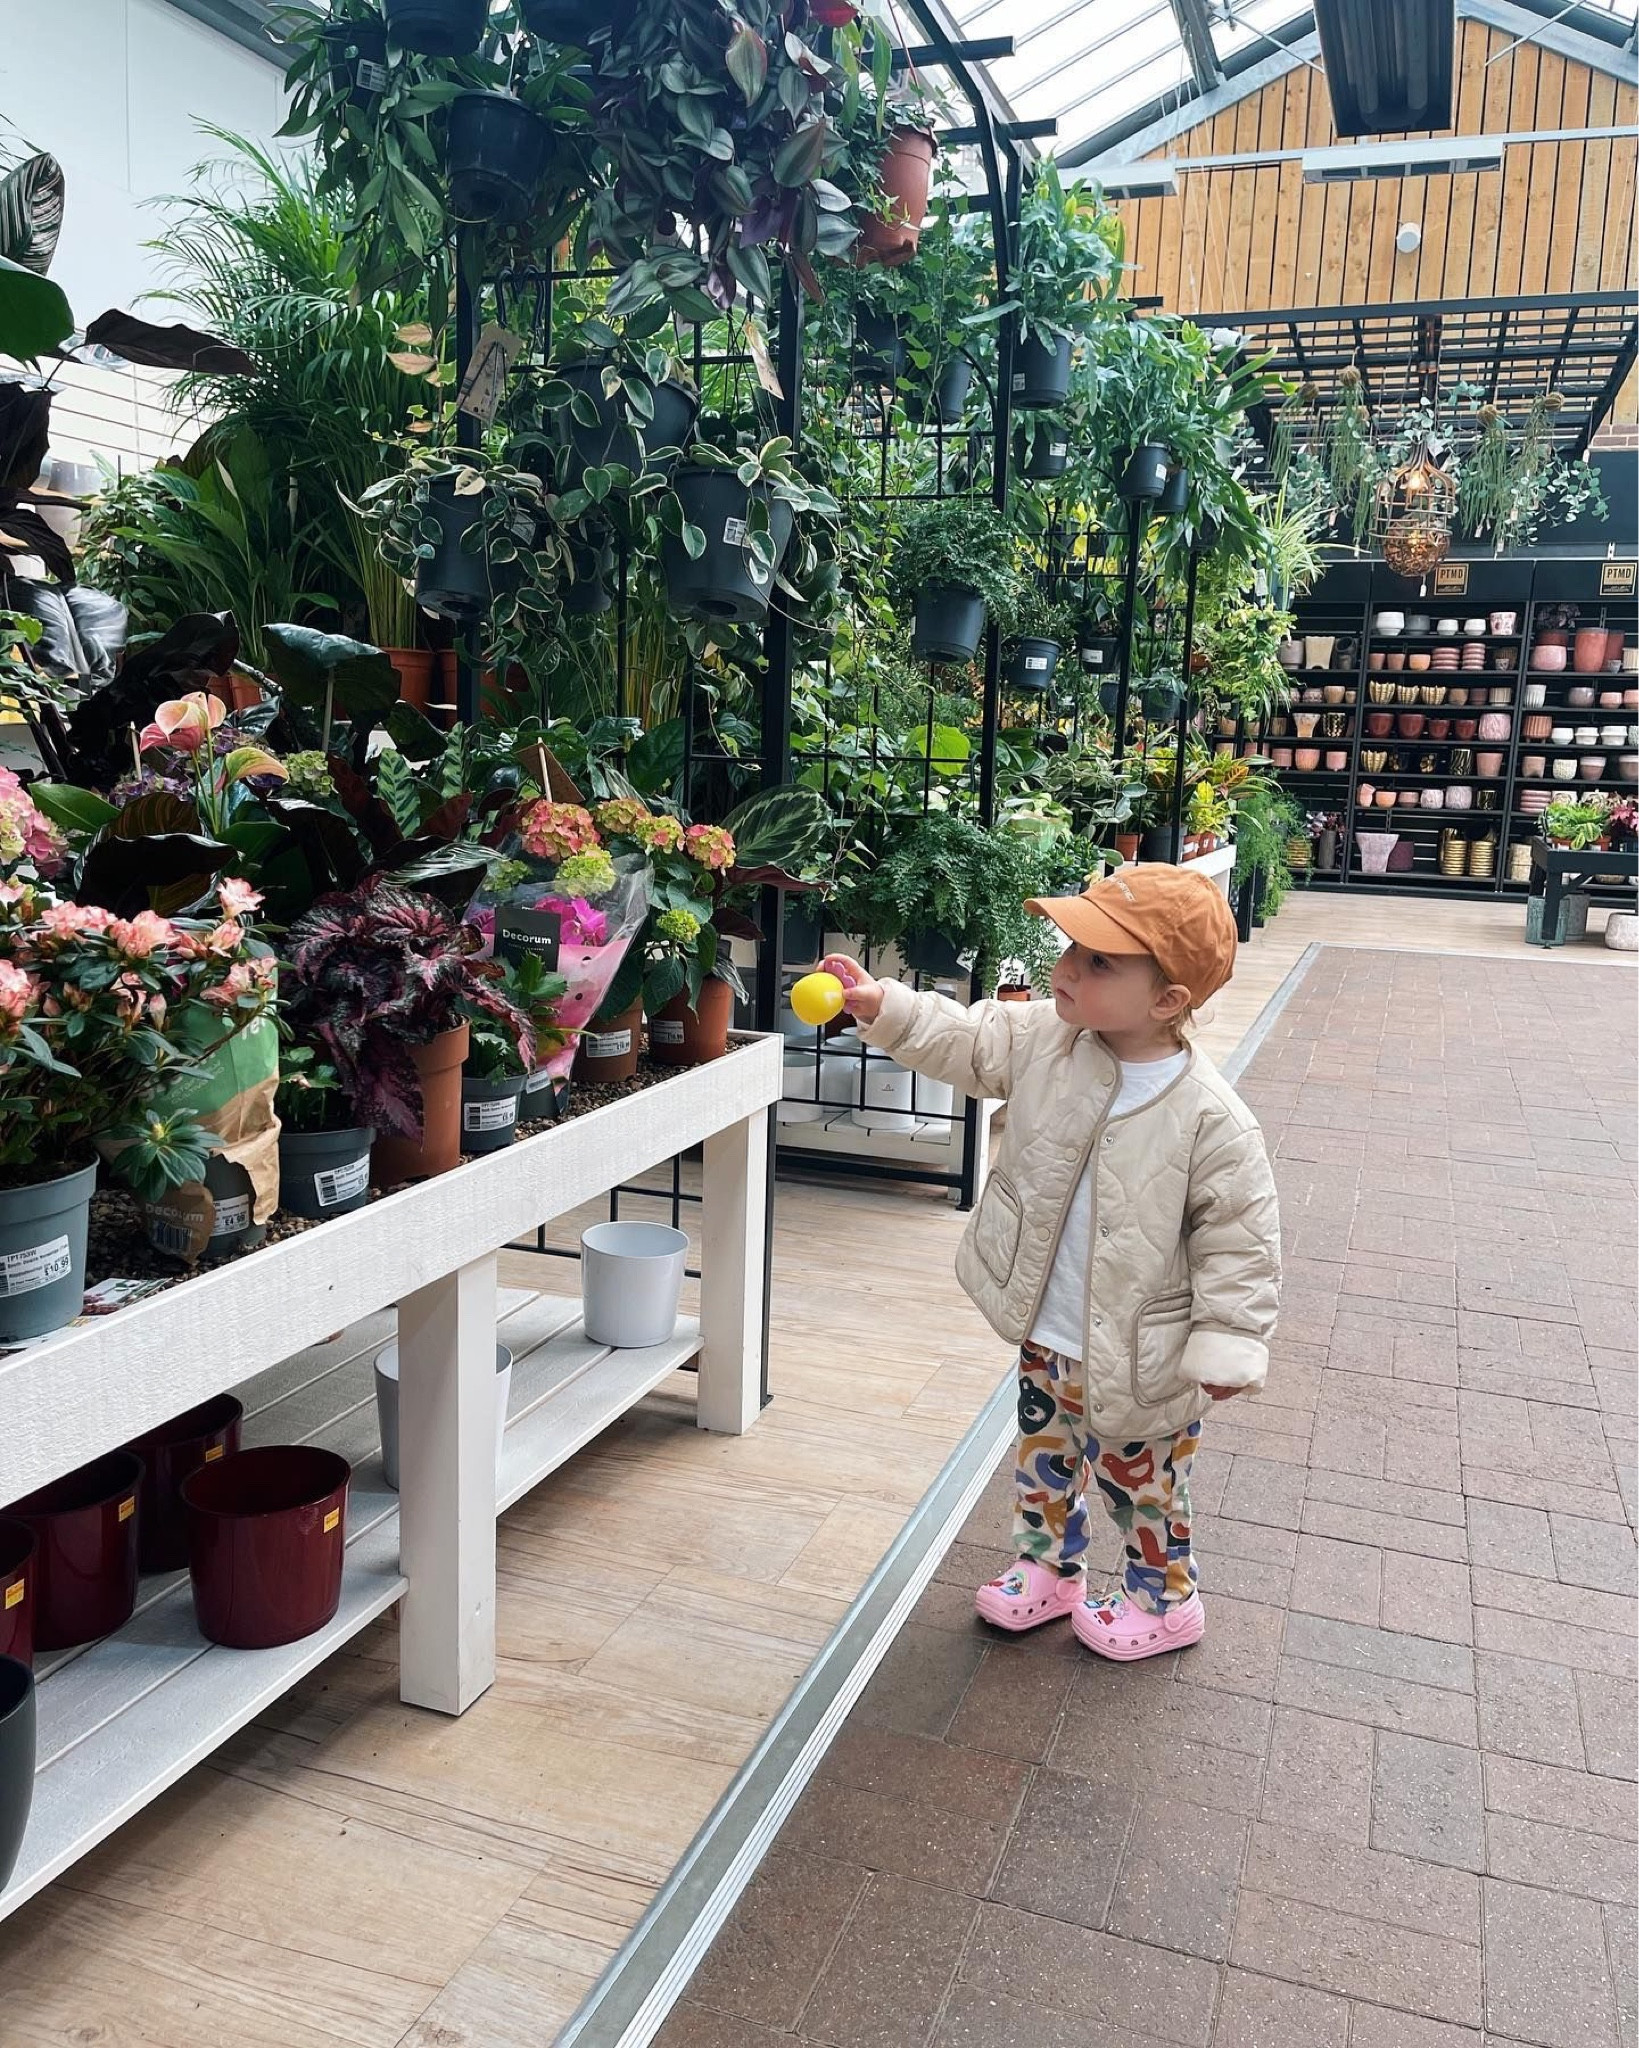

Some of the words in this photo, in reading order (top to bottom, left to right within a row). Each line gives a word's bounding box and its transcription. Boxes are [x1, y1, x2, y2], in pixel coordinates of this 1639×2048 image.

[1440, 569, 1463, 579] PTMD
[1607, 568, 1631, 579] PTMD
[502, 928, 552, 945] Decorum
